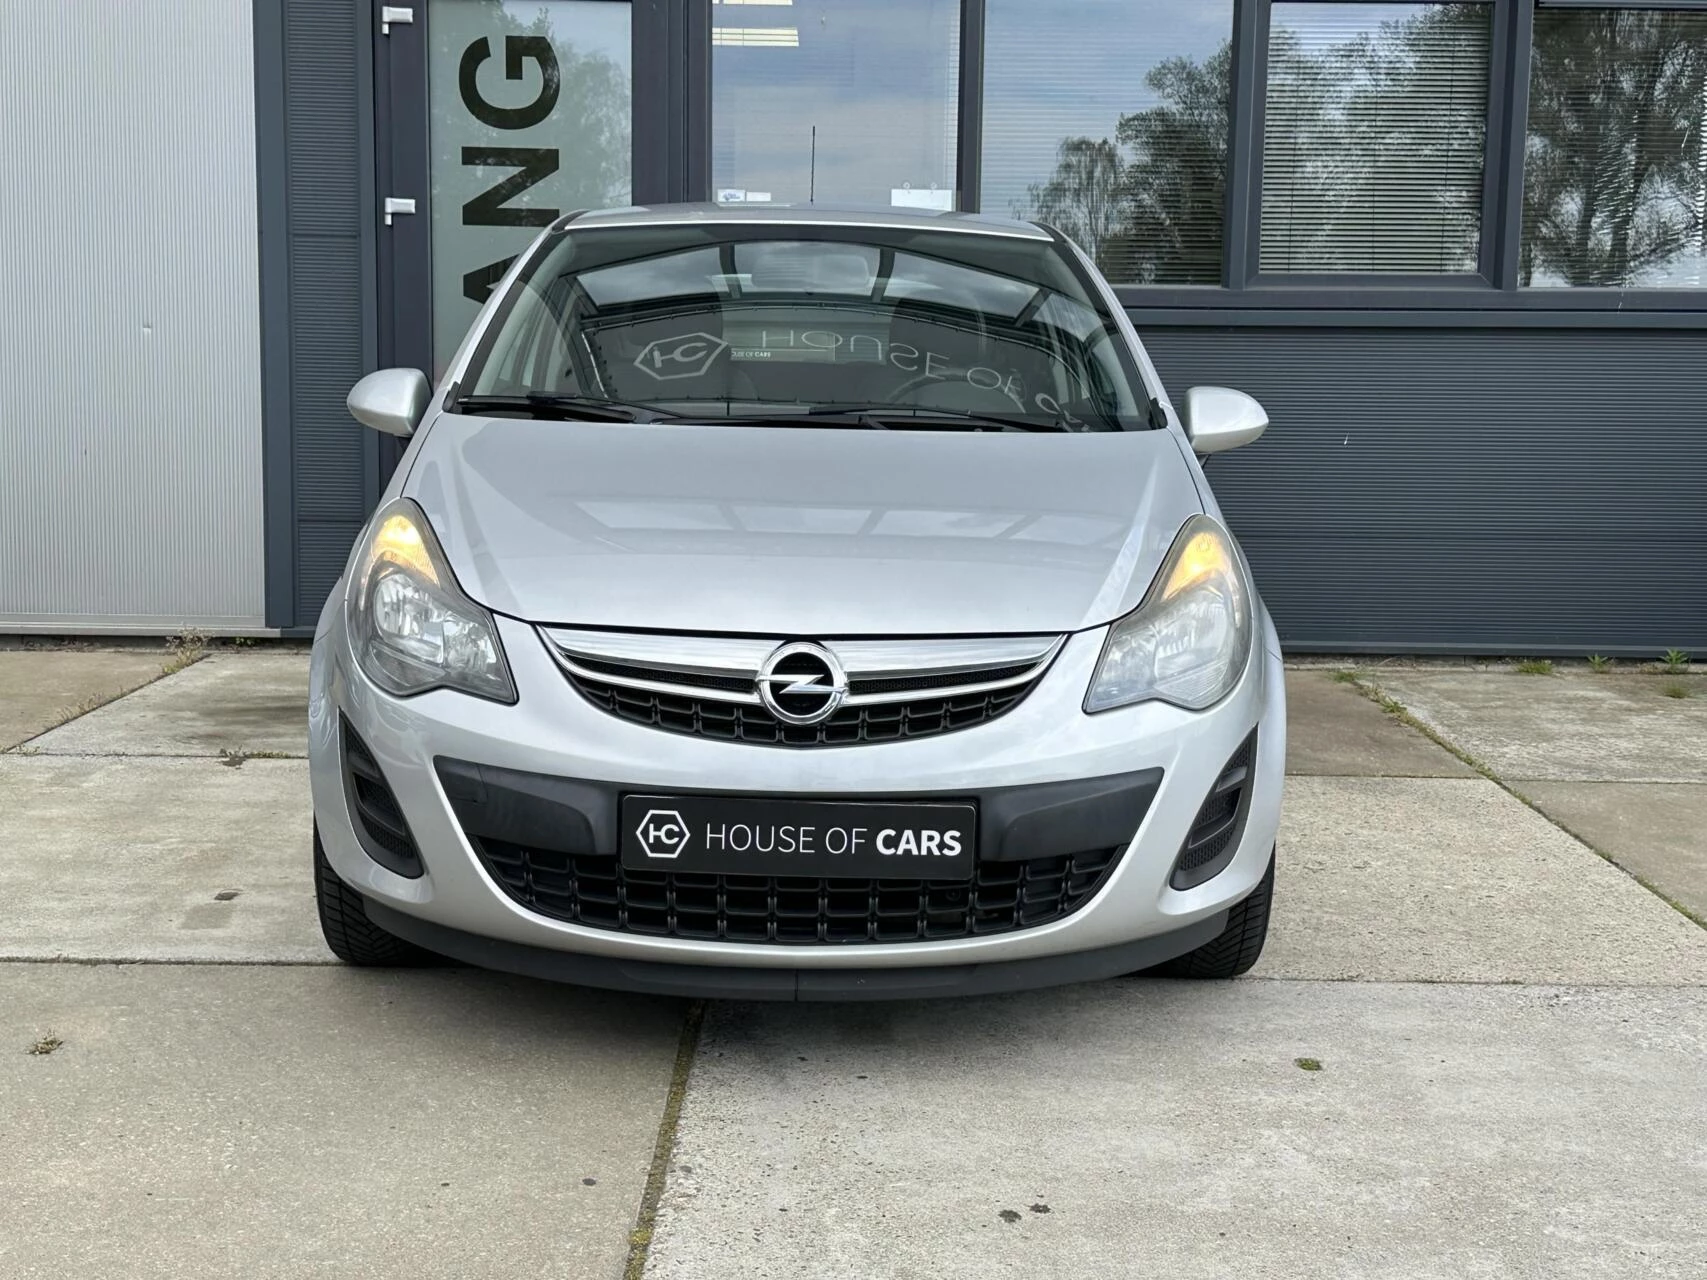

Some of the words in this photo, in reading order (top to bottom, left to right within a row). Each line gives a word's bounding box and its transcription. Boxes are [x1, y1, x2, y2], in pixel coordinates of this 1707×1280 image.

[706, 823, 816, 853] HOUSE
[825, 827, 868, 854] OF
[876, 829, 962, 856] CARS
